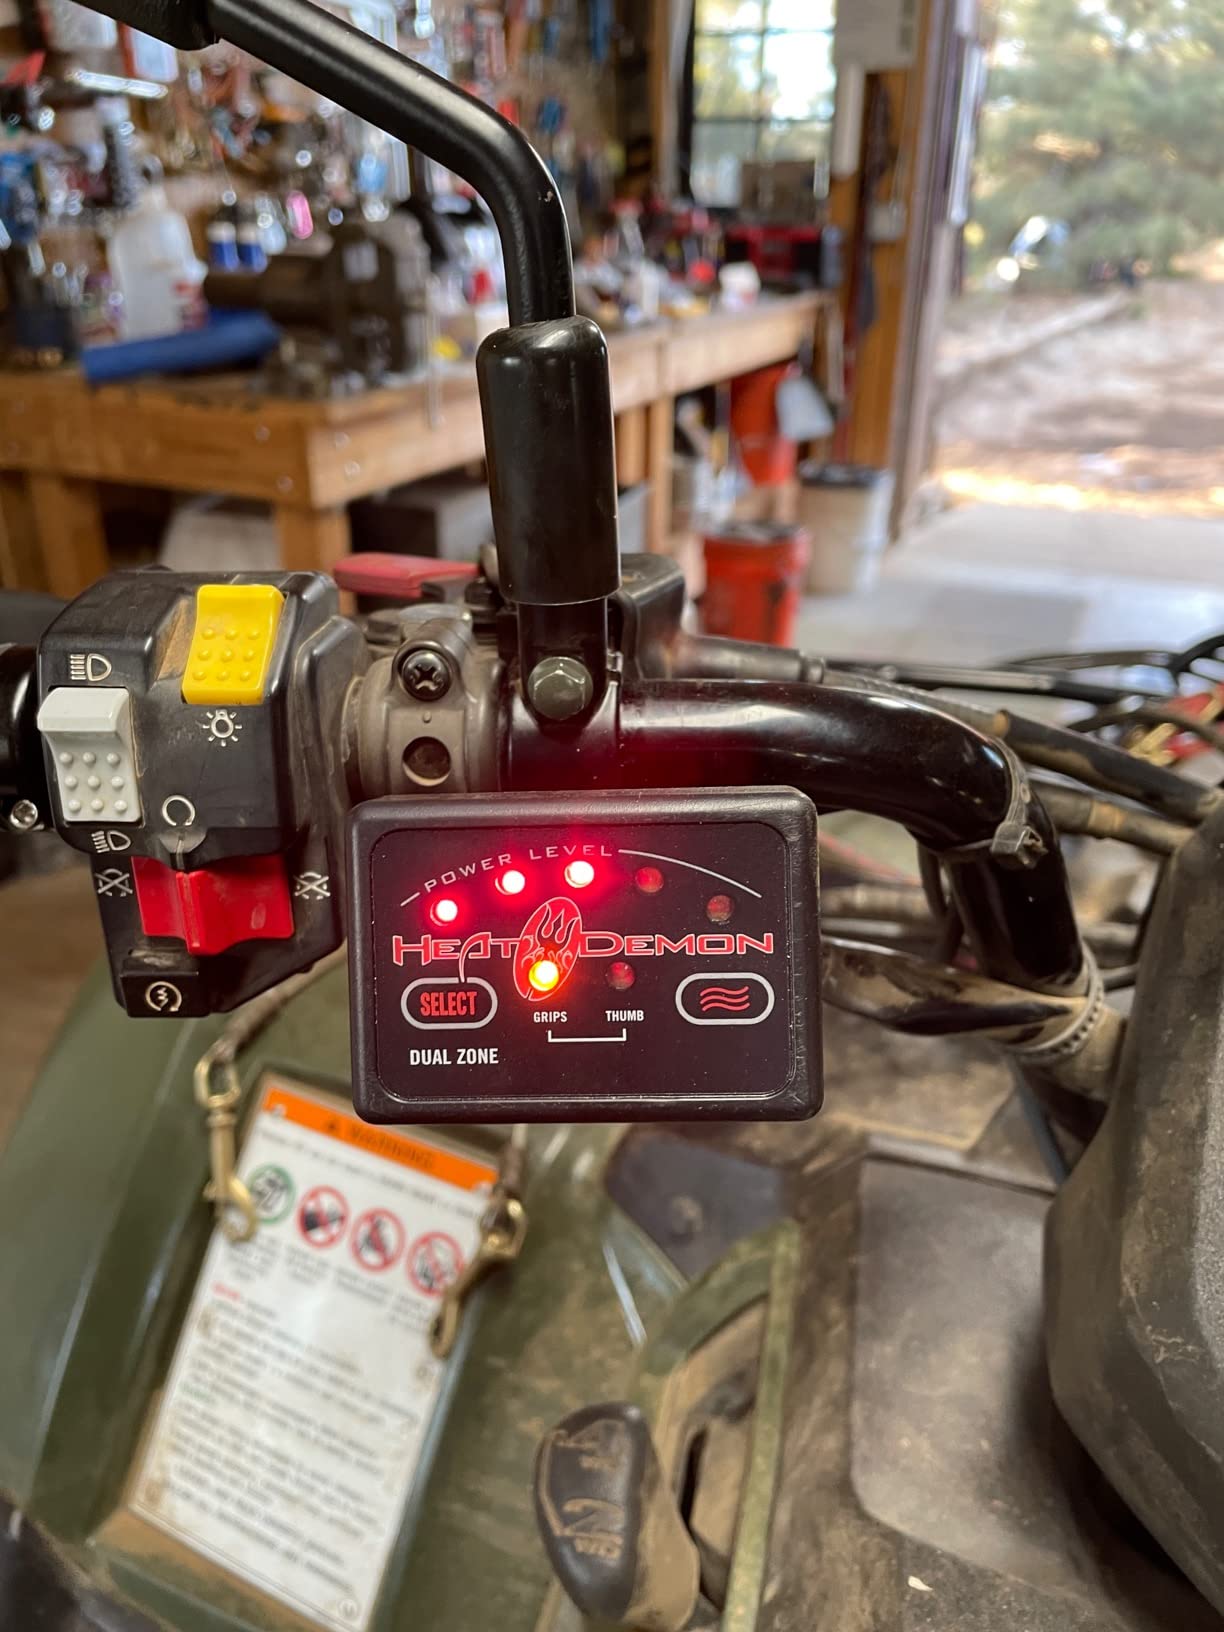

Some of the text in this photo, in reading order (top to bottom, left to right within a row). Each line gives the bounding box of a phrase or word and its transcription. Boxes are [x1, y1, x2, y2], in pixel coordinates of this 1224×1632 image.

[424, 844, 612, 893] POWER LEVEL
[392, 931, 774, 983] HEAT DEMON
[419, 991, 478, 1017] SELECT
[533, 1011, 568, 1023] GRIPS
[605, 1010, 645, 1022] THUMB
[409, 1047, 499, 1066] DUAL ZONE
